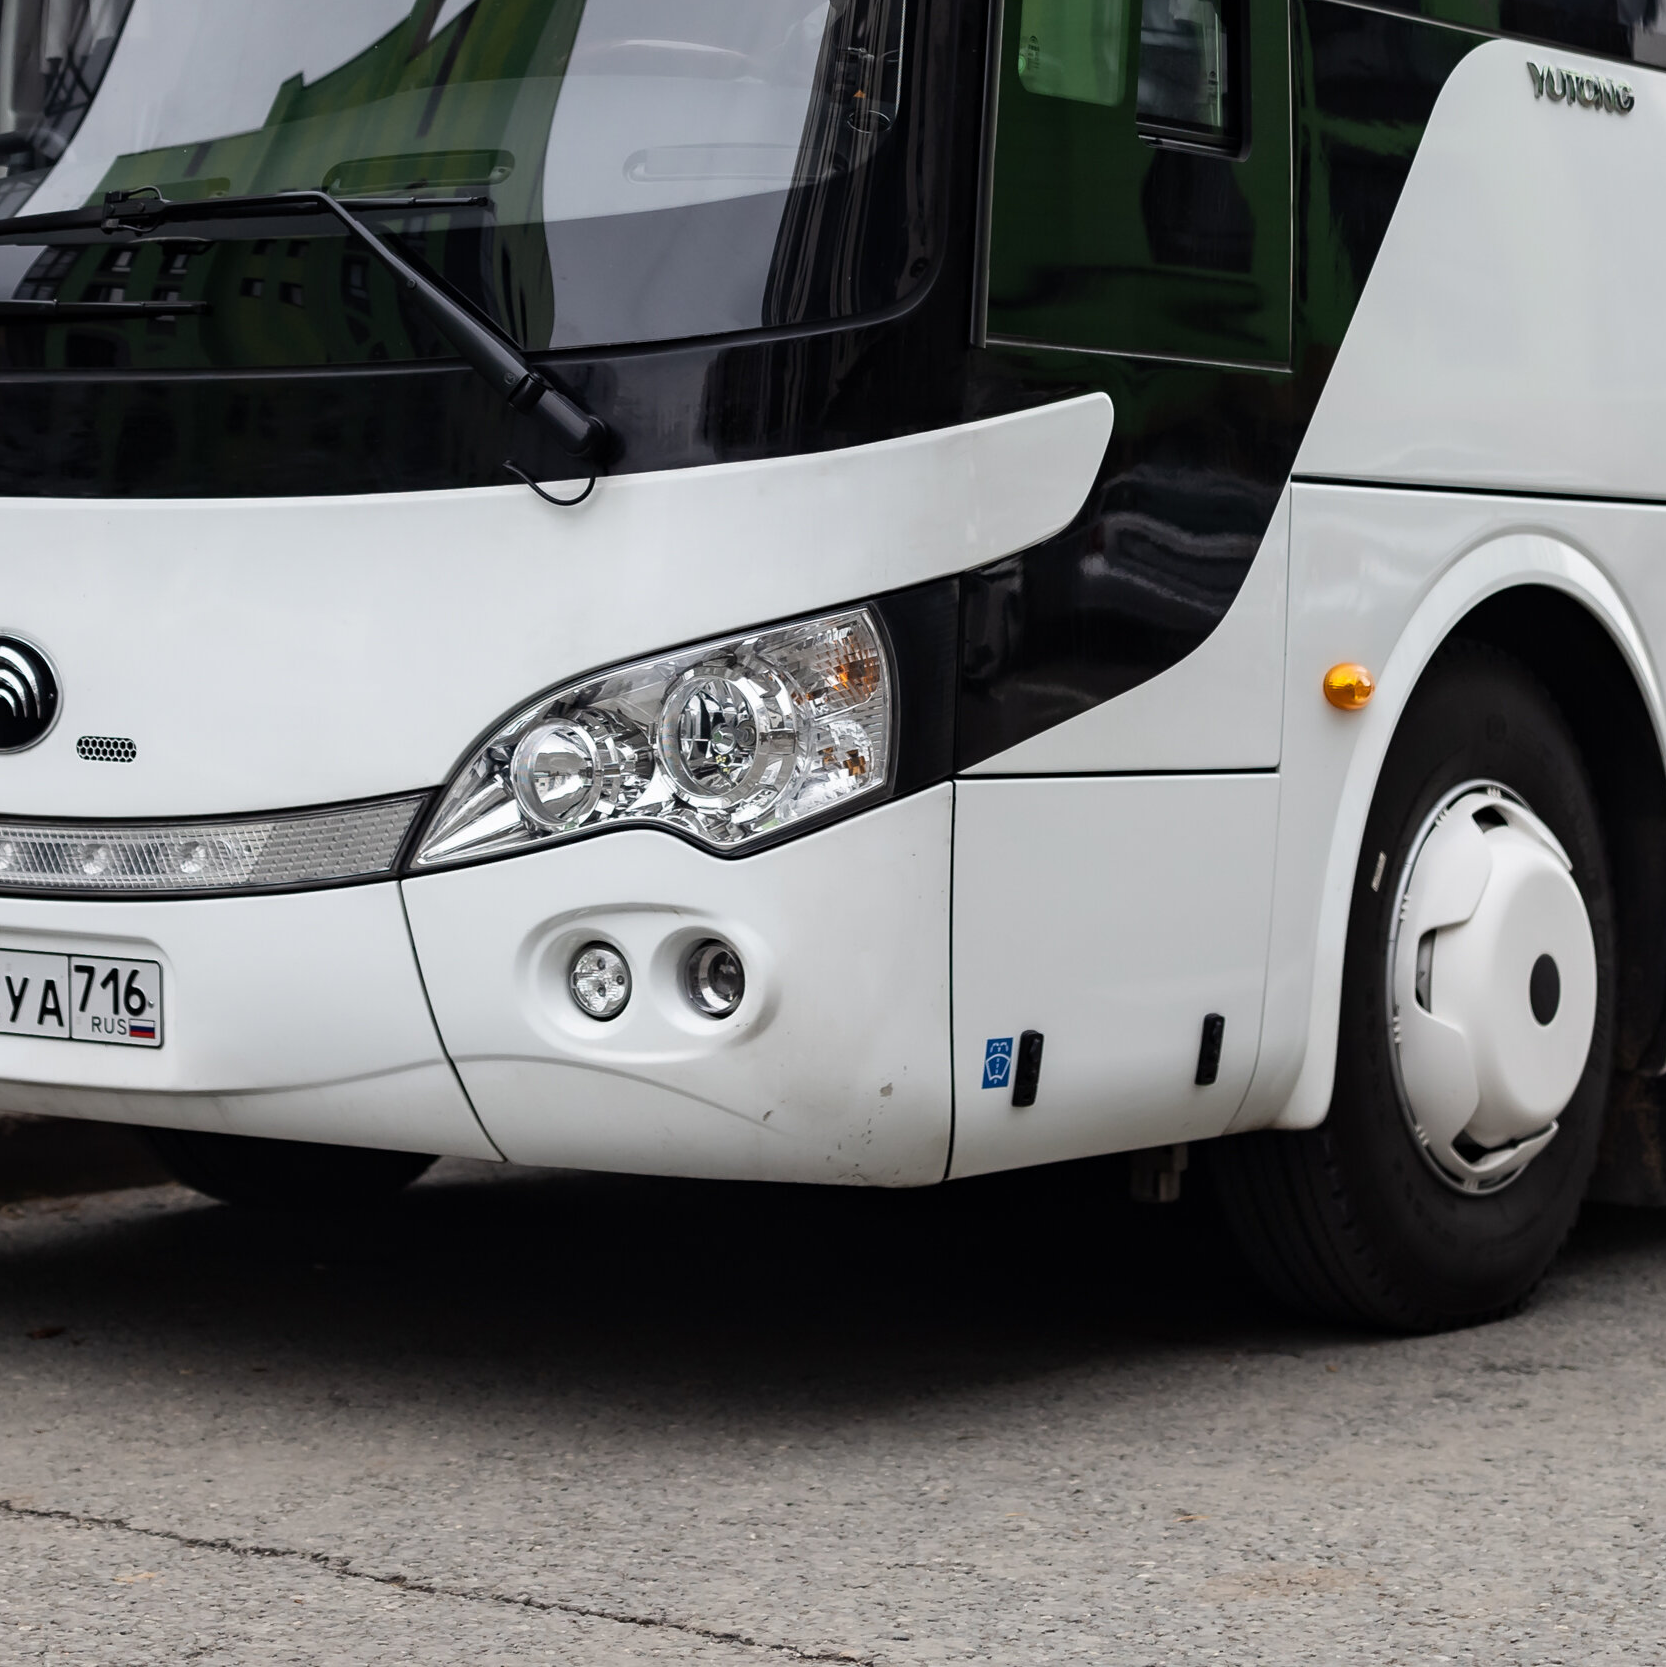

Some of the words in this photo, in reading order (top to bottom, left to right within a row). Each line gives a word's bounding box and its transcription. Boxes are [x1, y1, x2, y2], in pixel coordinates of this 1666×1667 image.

[1527, 62, 1636, 115] YUTONG
[73, 965, 147, 1016] 716
[91, 1016, 128, 1035] RUS
